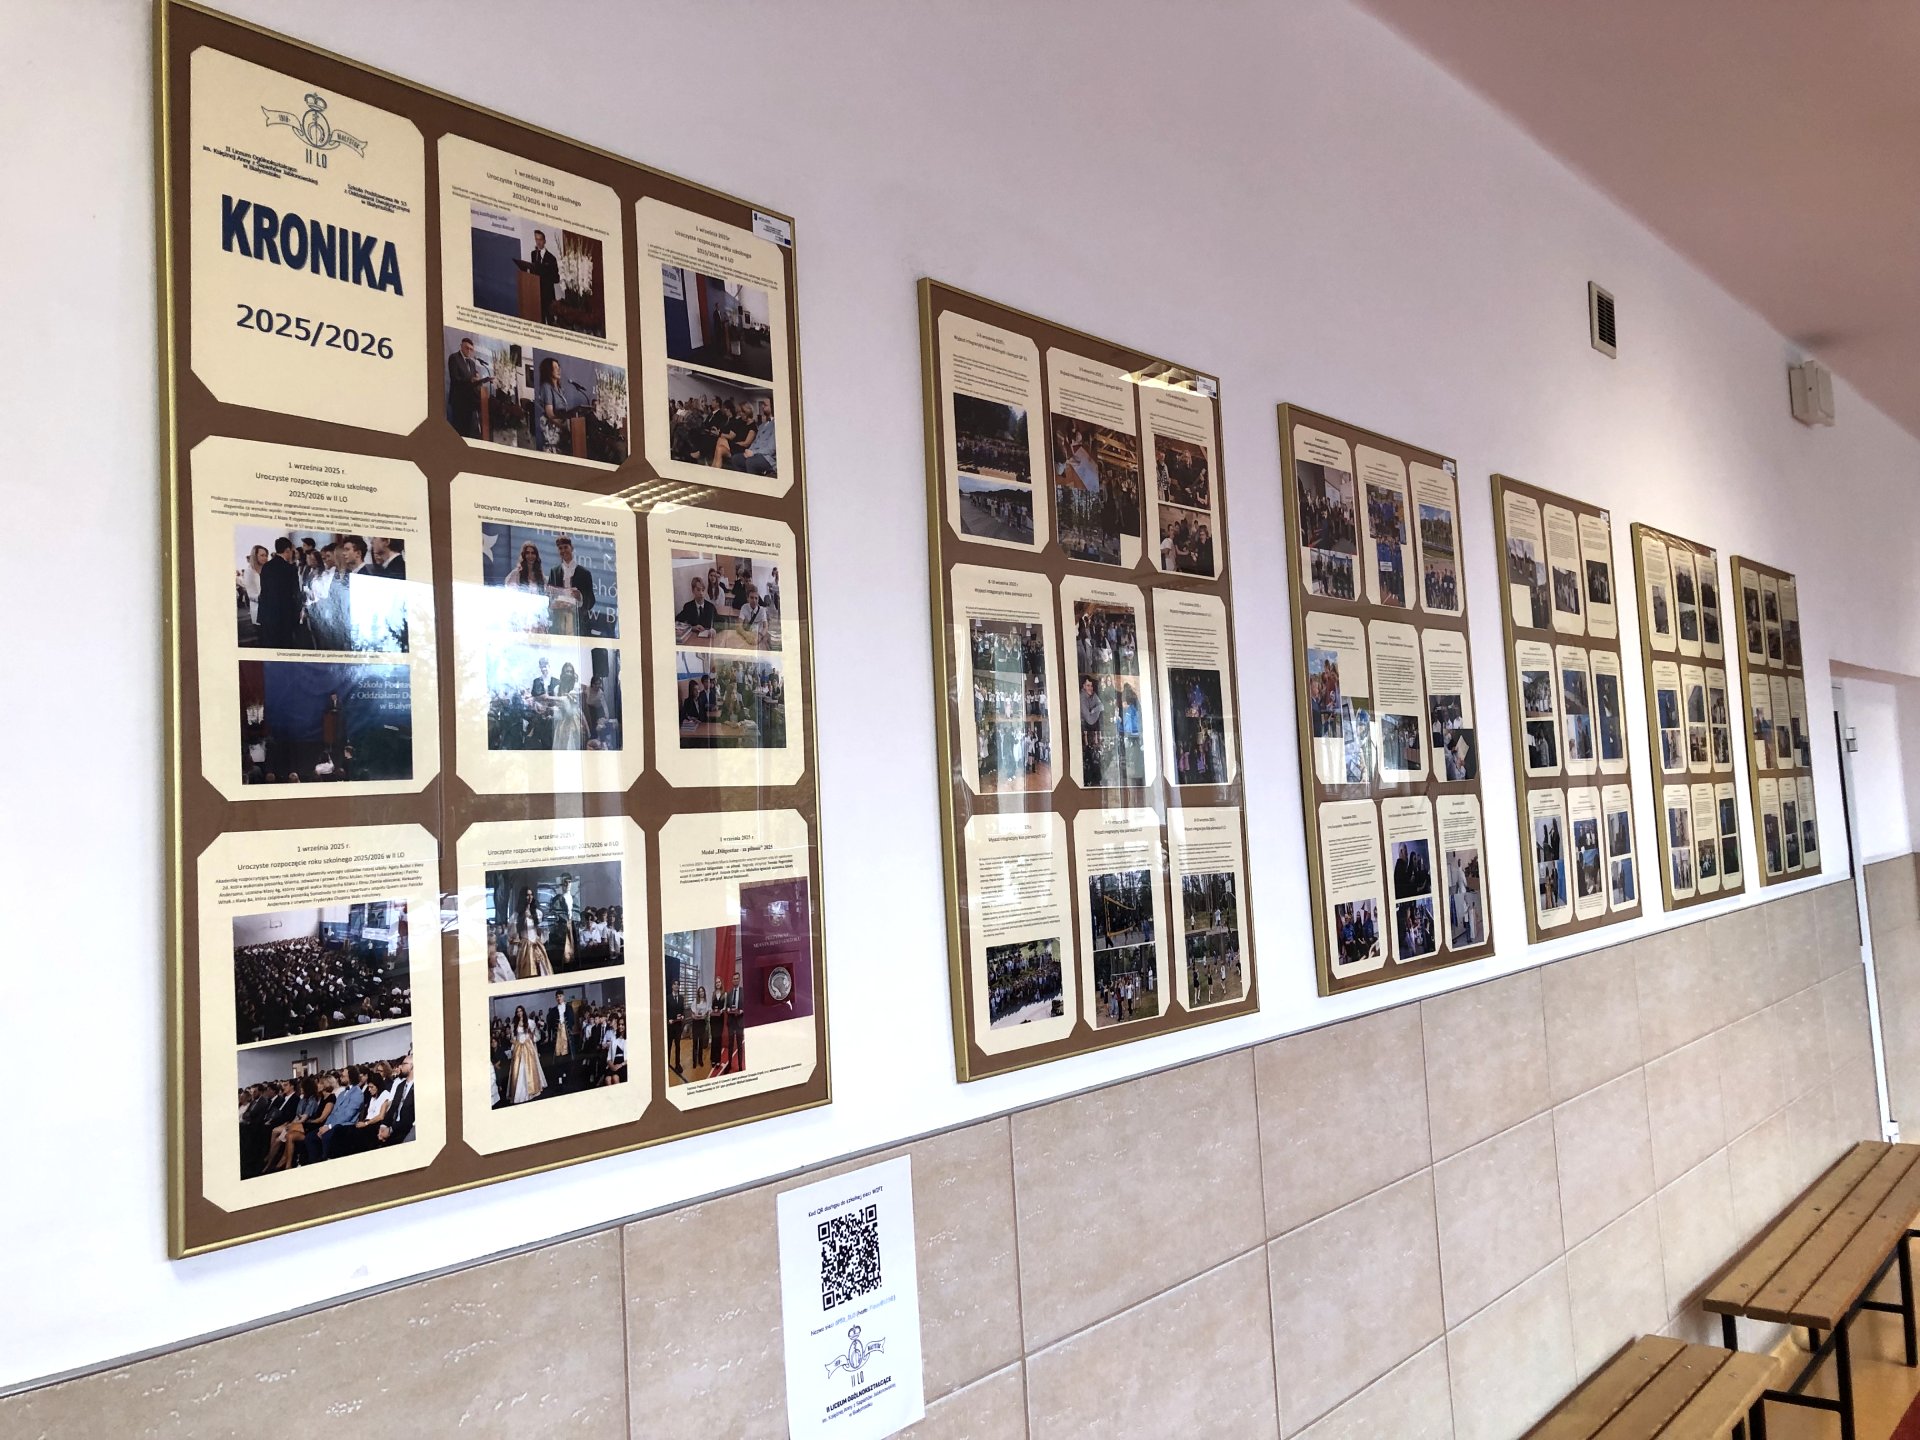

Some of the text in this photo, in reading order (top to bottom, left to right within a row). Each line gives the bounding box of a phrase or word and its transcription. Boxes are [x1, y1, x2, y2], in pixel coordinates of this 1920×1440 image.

[306, 148, 327, 169] II LO
[519, 171, 541, 183] września
[542, 177, 555, 187] 2025
[487, 172, 581, 207] Uroczyste rozpoczęcie roku szkolnego
[512, 192, 540, 207] 2025/2026
[222, 193, 404, 297] KRONIKA
[236, 303, 394, 359] 2025/2026
[293, 463, 323, 473] września
[324, 466, 340, 475] 2025
[255, 472, 378, 493] Uroczyste rozpoczęcie roku szkolnego
[289, 490, 324, 501] 2025/2026
[339, 495, 348, 503] LO
[529, 498, 552, 507] września
[474, 502, 501, 514] Uroczyste
[502, 506, 533, 517] rozpoczęcie
[534, 510, 546, 518] roku
[547, 511, 573, 522] szkolnego
[573, 515, 600, 526] 2025/2026
[666, 528, 687, 536] Uroczyste
[688, 531, 713, 540] rozpoczęcie
[725, 535, 745, 544] szkolnego
[745, 538, 767, 547] 2025/2026
[358, 680, 382, 689] Szkoła
[357, 691, 400, 699] Oddziałami
[302, 843, 329, 852] września
[330, 843, 345, 851] 2025
[487, 848, 513, 856] Uroczyste
[513, 846, 542, 854] rozpoczęcie
[237, 862, 269, 870] Uroczyste
[270, 859, 307, 869] rozpoczęcie
[323, 855, 353, 865] szkolnego
[353, 853, 385, 862] 2025/2026
[851, 1370, 865, 1388] II LO
[830, 1398, 847, 1411] LICEUM
[847, 1375, 892, 1402] OGÓLNOKSZTAŁCĄCE
